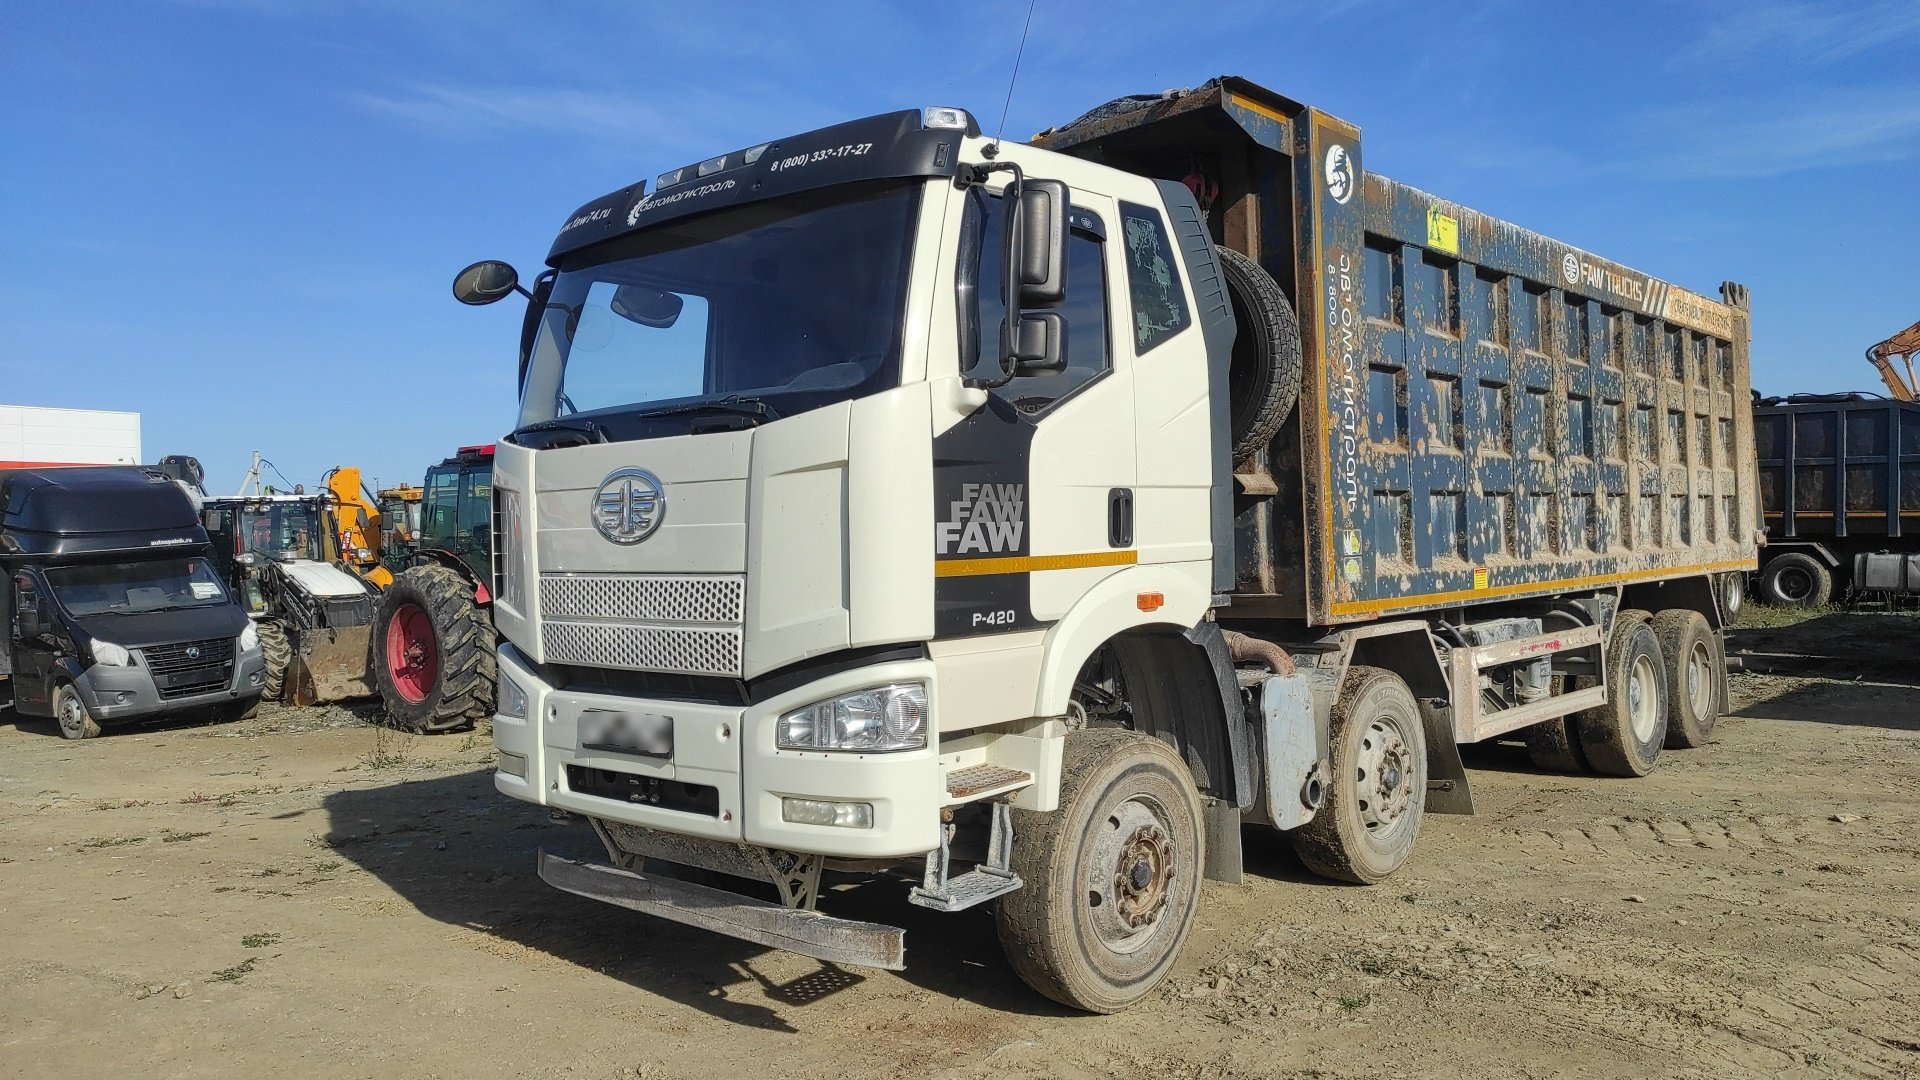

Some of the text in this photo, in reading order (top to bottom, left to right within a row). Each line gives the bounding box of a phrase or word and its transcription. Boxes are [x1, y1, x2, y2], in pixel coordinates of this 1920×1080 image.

[771, 161, 779, 172] 8
[780, 153, 809, 172] (800)
[1580, 262, 1605, 290] FAW
[963, 484, 1023, 505] FAW
[951, 501, 1023, 526] FAW
[936, 521, 1023, 554] FAW
[972, 610, 1016, 626] P-420
